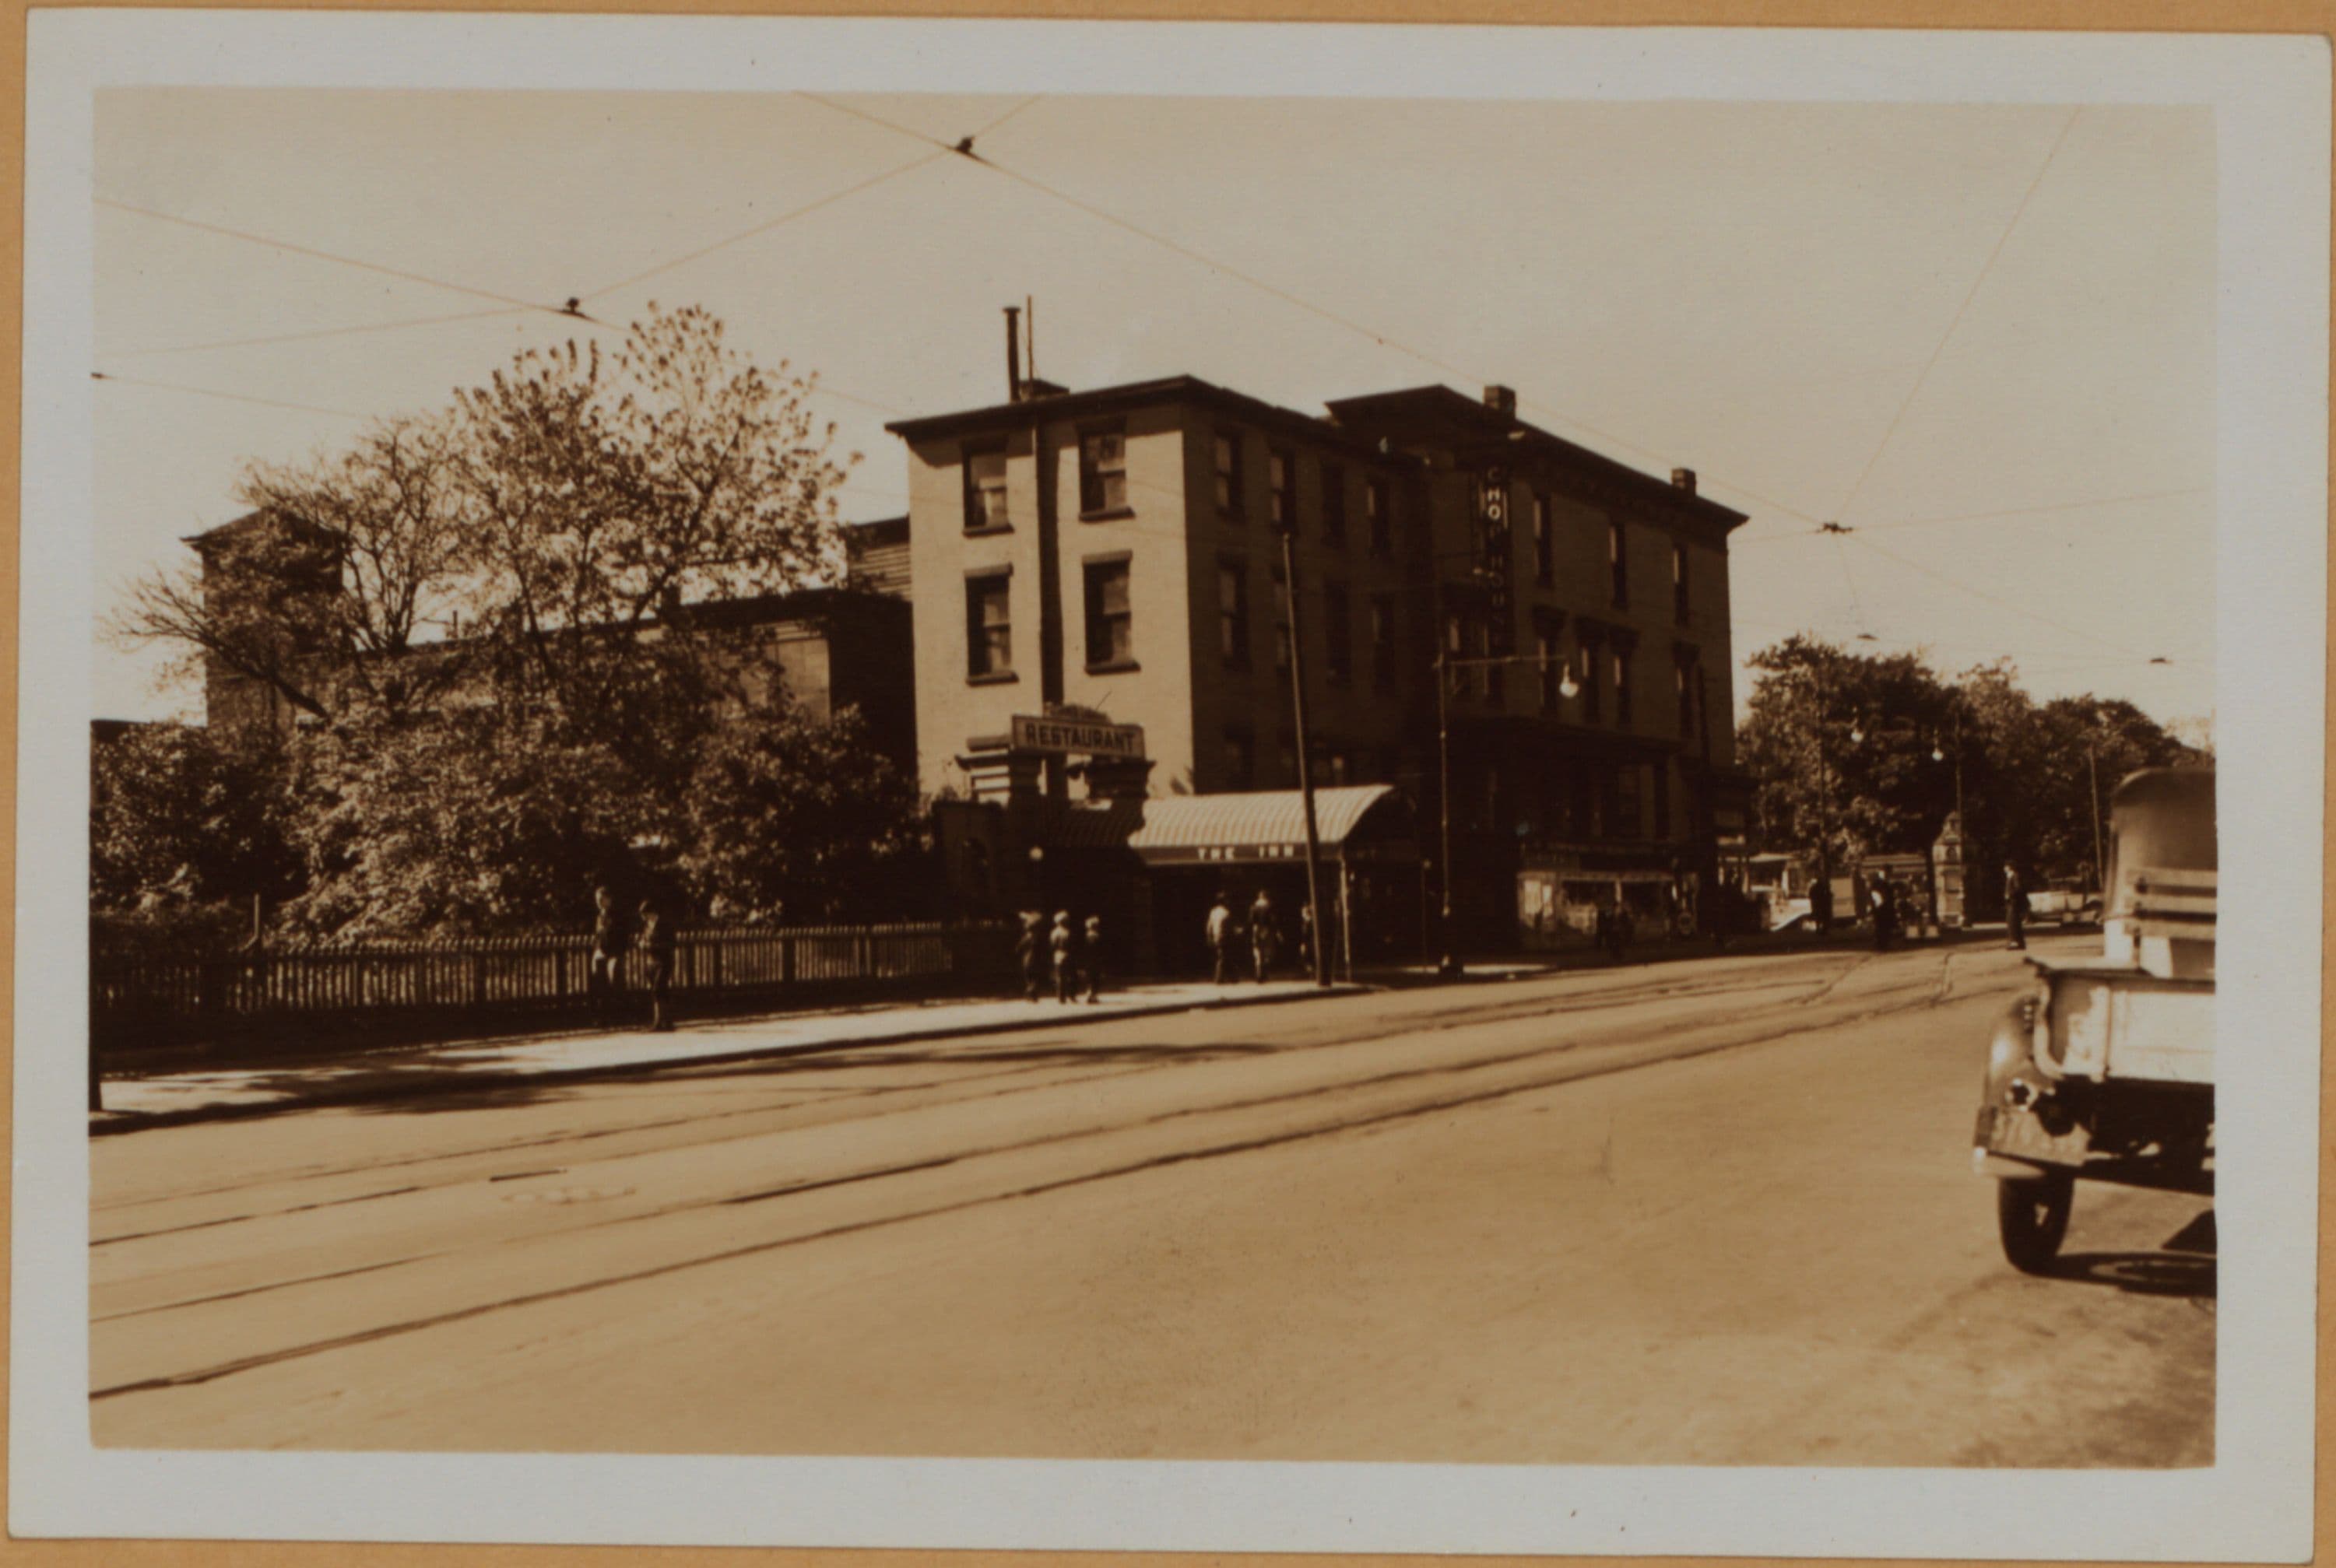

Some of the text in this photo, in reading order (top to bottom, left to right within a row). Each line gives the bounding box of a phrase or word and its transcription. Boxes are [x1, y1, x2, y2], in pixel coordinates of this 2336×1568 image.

[1025, 723, 1136, 752] RESTAURANT
[1197, 845, 1294, 861] THE INN
